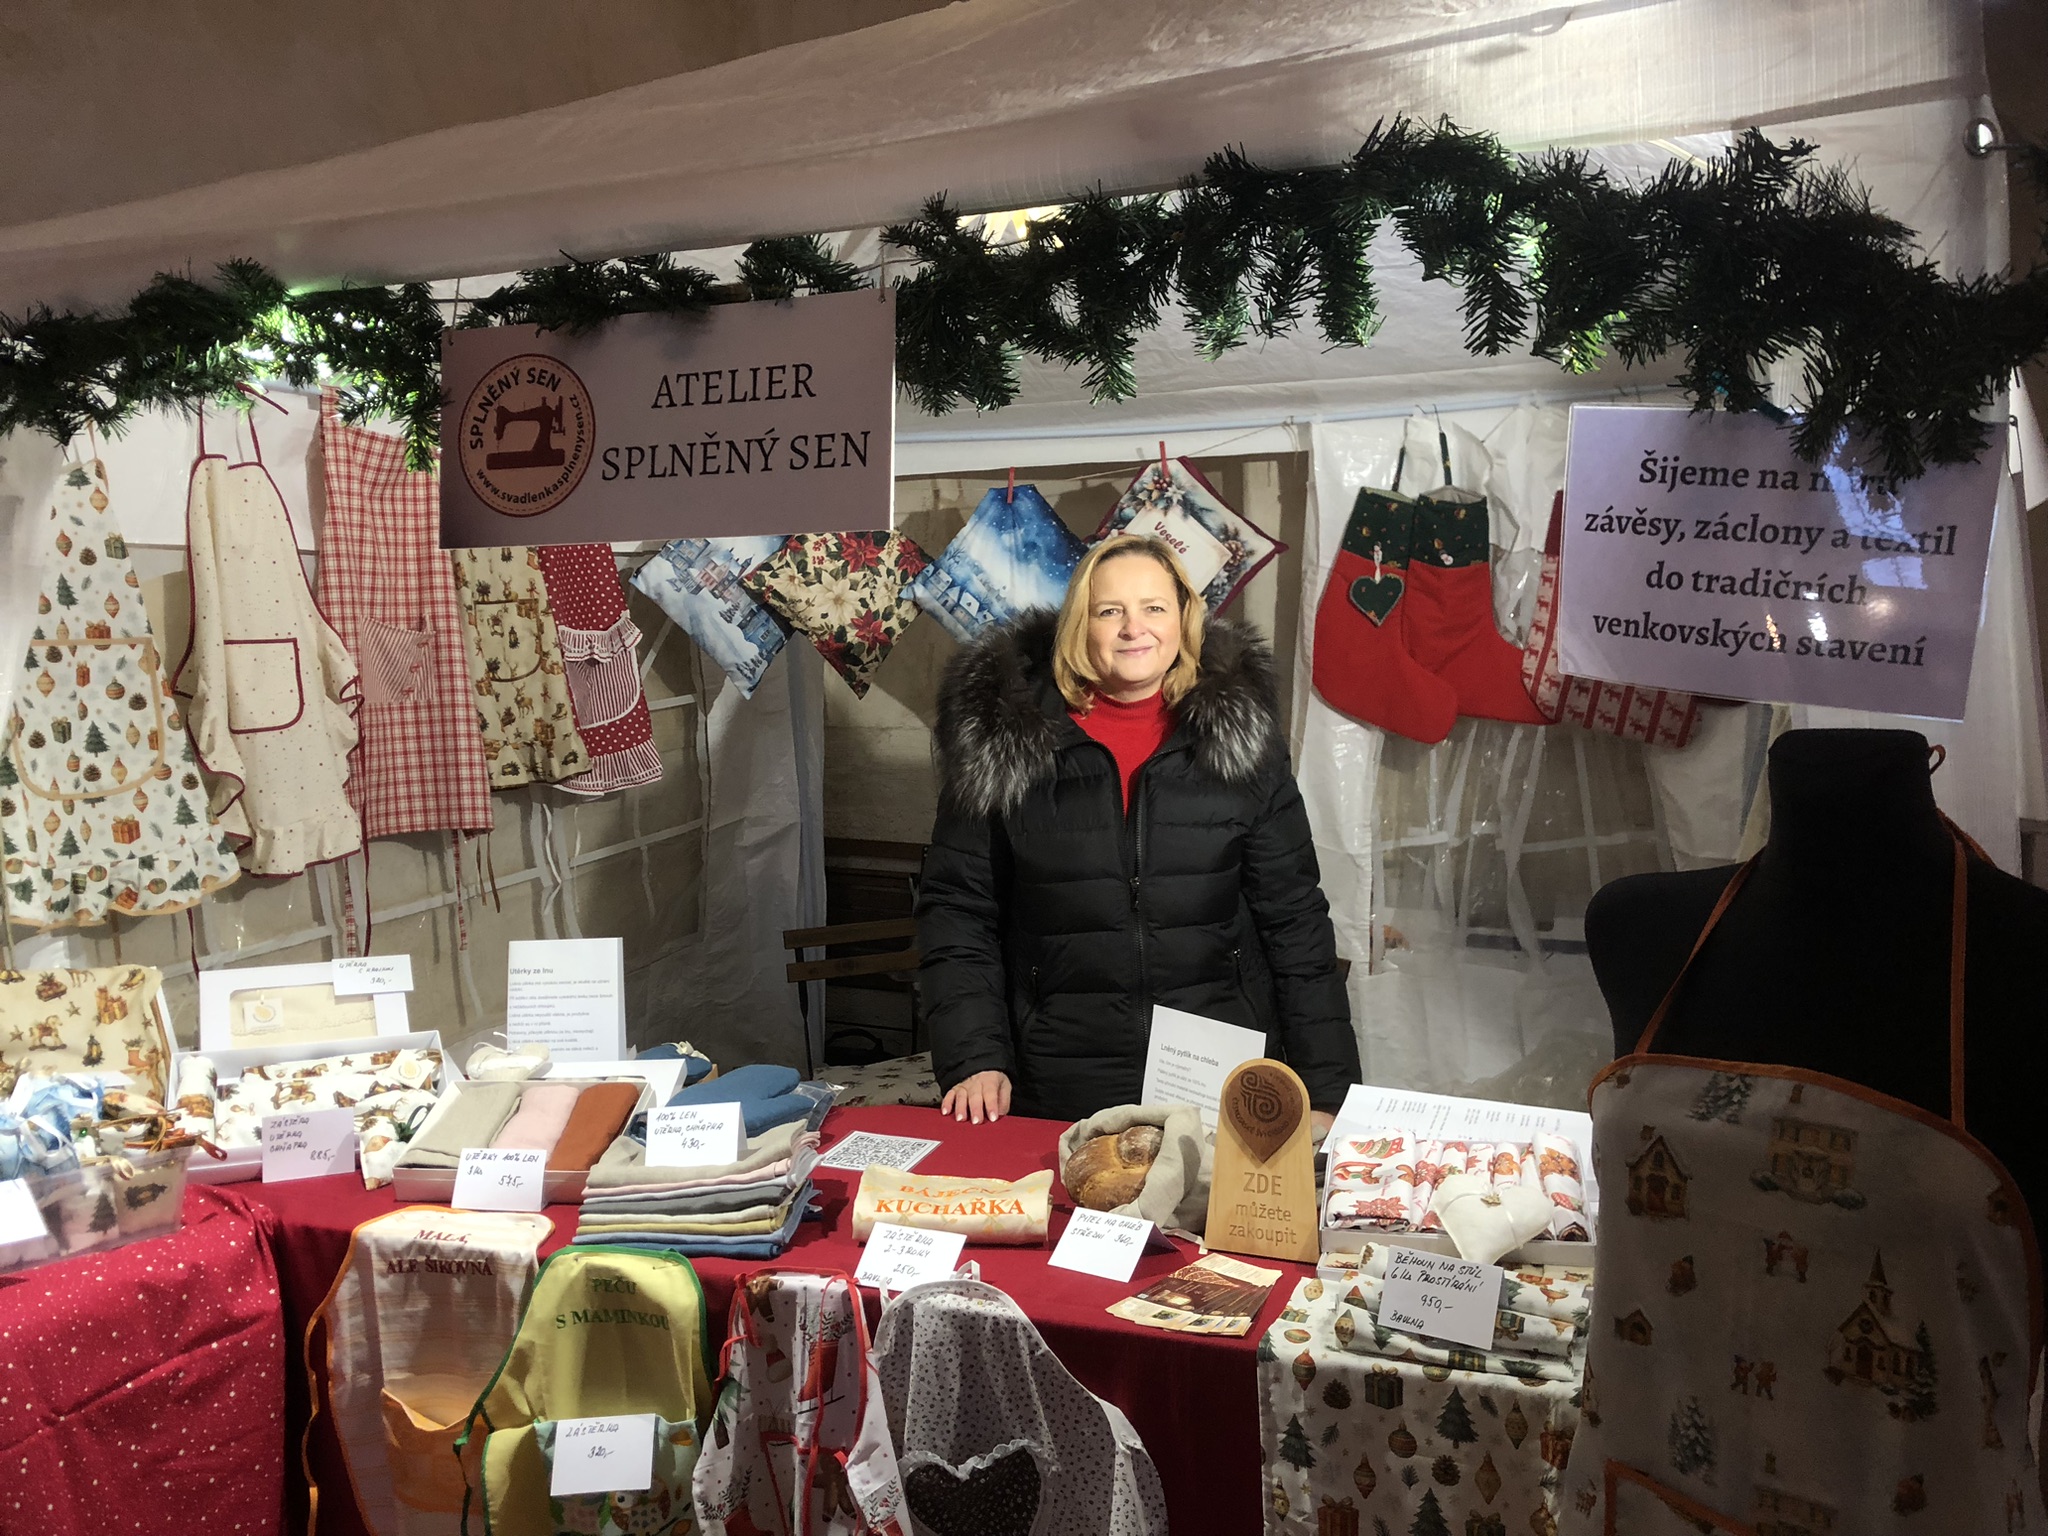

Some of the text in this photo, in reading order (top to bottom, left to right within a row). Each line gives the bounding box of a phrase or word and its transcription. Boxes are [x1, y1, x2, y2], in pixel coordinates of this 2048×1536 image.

[651, 363, 816, 409] ATELIER
[470, 366, 561, 449] SPLNĚNÝ SEN
[476, 393, 586, 503] www.svadlenkasplnenysen.cz
[602, 427, 871, 481] SPLNĚNÝ SEN
[1639, 450, 1749, 492] Šijeme
[1757, 468, 1799, 491] na
[1154, 521, 1190, 555] Veselé
[1585, 506, 1685, 544] závěsy,
[1694, 513, 1824, 554] záclony
[1831, 528, 1850, 549] a
[1646, 561, 1867, 606] do tradičních
[1593, 611, 1926, 667] venkovských stavení
[509, 967, 531, 976] Utěrky
[656, 1111, 698, 1122] 100% LEN
[502, 1153, 520, 1162] 100%
[522, 1154, 539, 1163] LEN
[1243, 1172, 1282, 1196] ZDE
[874, 1198, 1026, 1216] KUCHAŘKA
[1235, 1201, 1291, 1222] můžete
[1077, 1213, 1102, 1225] PYTEL
[1104, 1218, 1117, 1227] NA
[1229, 1222, 1297, 1247] zakoupit
[386, 1255, 495, 1277] ALE ŠIKOVNÁ
[1390, 1266, 1399, 1279] 6
[1395, 1250, 1436, 1270] BĚHOUN
[1438, 1261, 1456, 1273] NA
[591, 1276, 638, 1295] PEČU
[860, 1272, 892, 1285] BAVLA
[556, 1308, 670, 1331] S MAMINKOU
